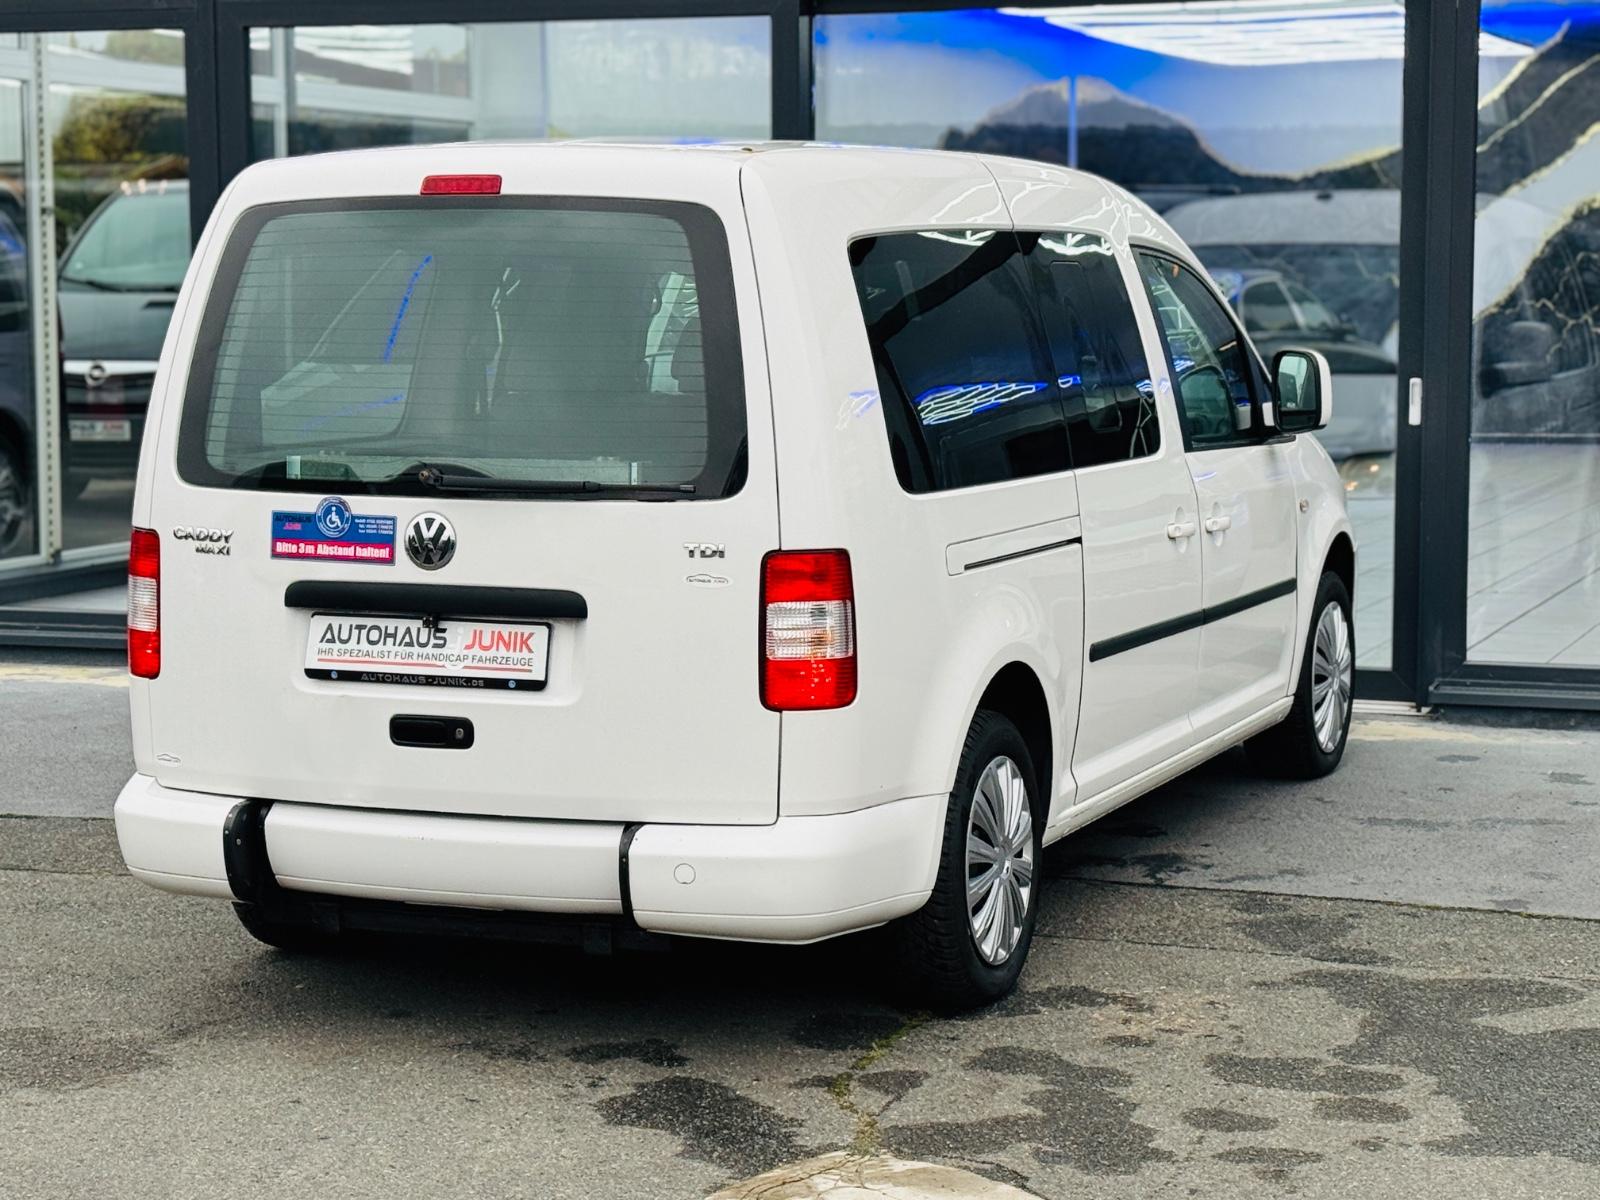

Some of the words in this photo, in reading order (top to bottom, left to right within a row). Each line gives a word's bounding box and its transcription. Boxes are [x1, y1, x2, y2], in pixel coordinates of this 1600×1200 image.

[173, 526, 234, 544] CADDY
[195, 544, 231, 556] MAXI
[276, 541, 298, 554] Bitte
[317, 544, 355, 556] Abstand
[683, 542, 725, 559] TDI
[319, 622, 447, 649] AUTOHAUS
[464, 629, 536, 654] JUNIK
[317, 647, 334, 657] IHR
[336, 649, 392, 660] SPEZIALIST
[394, 649, 415, 661] FÜR
[416, 652, 469, 663] HANDICAP
[471, 655, 534, 667] FAHRZEUGE
